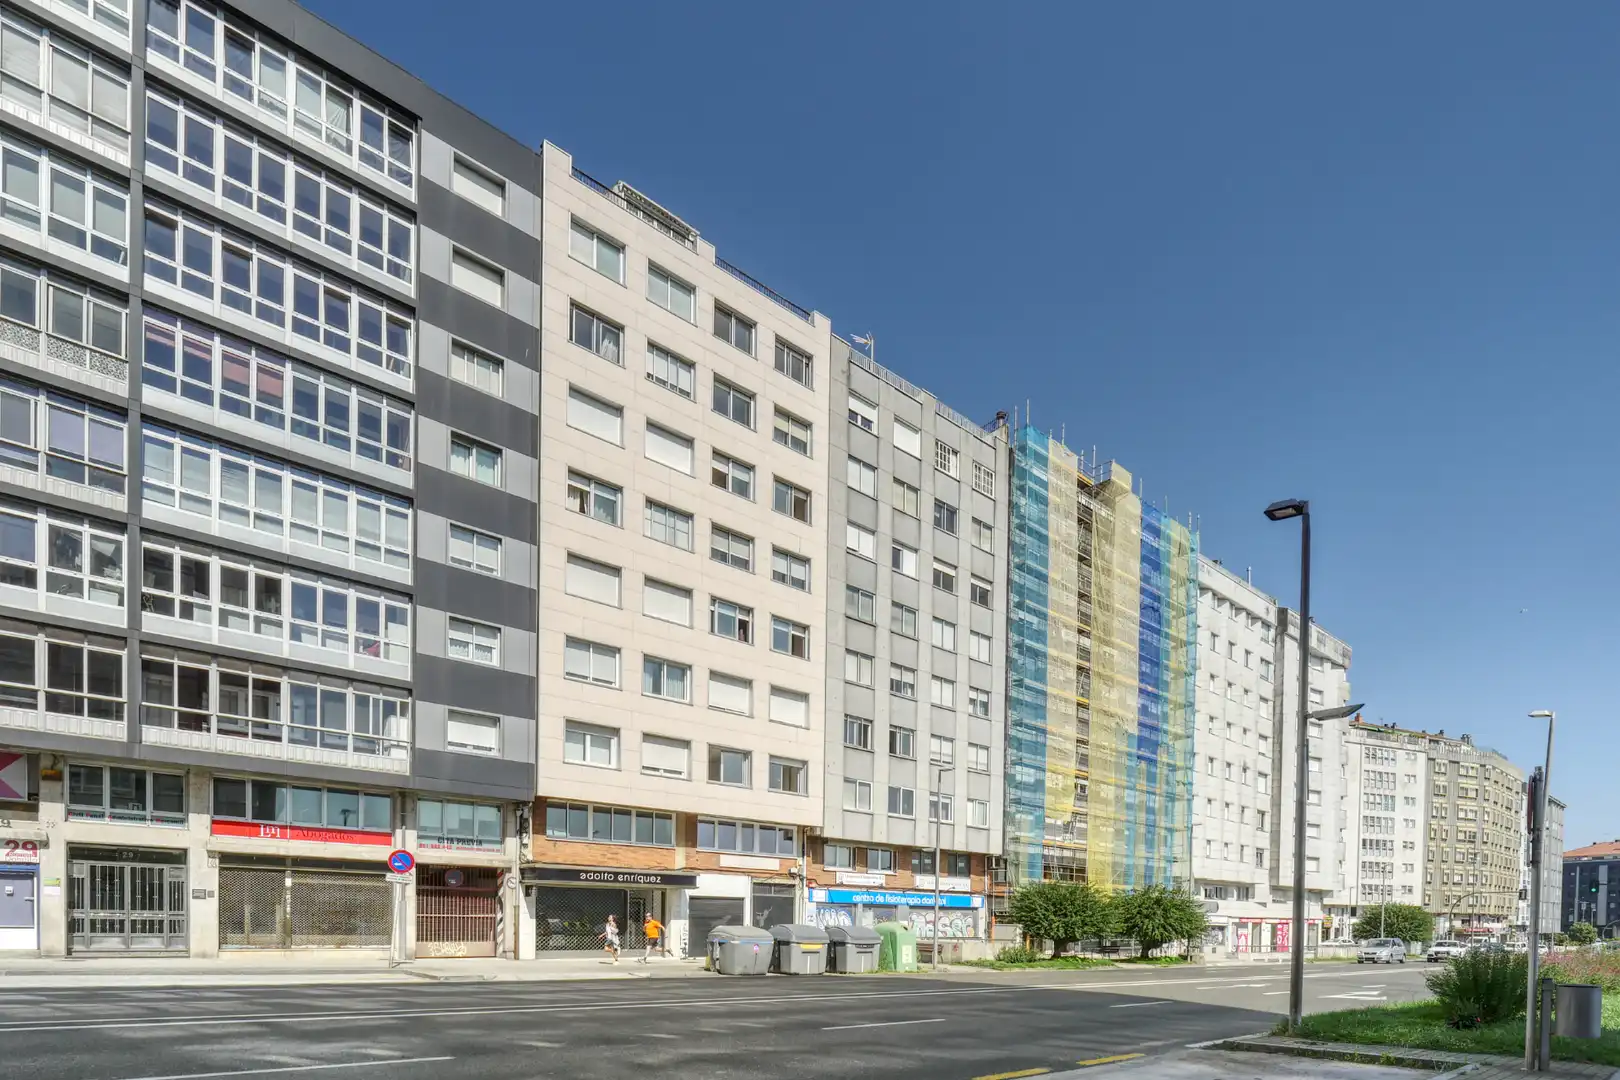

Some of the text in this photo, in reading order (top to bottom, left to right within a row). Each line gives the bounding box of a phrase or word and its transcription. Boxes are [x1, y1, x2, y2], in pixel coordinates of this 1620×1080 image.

[296, 828, 355, 841] Abogados
[4, 839, 38, 857] 29
[456, 837, 483, 847] PREVIA
[579, 872, 614, 881] adolfo
[852, 893, 874, 902] centro
[875, 894, 885, 903] de
[885, 895, 921, 905] fisioterapia
